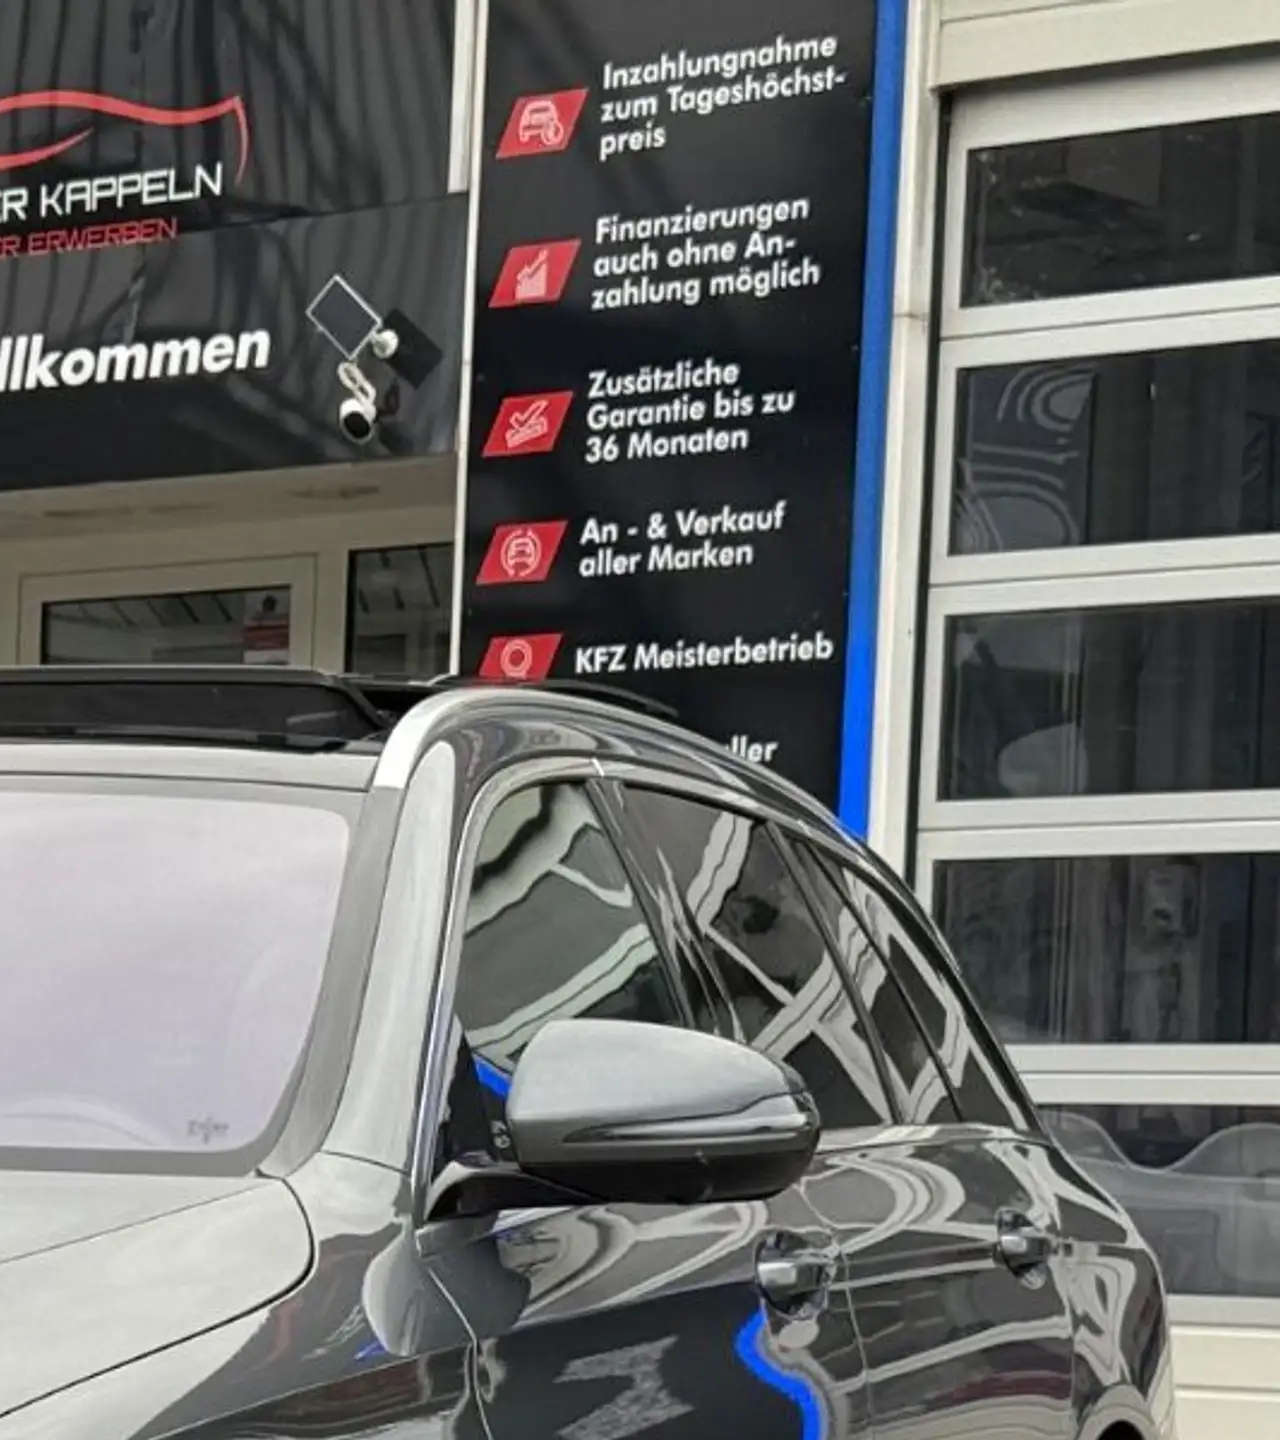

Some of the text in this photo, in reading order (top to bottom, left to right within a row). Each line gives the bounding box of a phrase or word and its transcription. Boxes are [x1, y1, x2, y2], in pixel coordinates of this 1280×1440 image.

[603, 33, 838, 90] Inzahlungnahme
[600, 67, 846, 123] zum Tageshöchst-
[598, 121, 666, 162] preis
[41, 161, 223, 219] KAPPELN
[28, 216, 178, 256] ERWERBEN
[595, 198, 810, 245] Finanzierungen
[593, 231, 796, 277] auch ohne An-
[590, 258, 820, 312] zahlung möglich
[588, 359, 740, 399] Zusätzliche
[586, 389, 796, 431] Garantie bis zu
[584, 427, 749, 464] 36 Monaten
[647, 511, 669, 540] &
[674, 501, 787, 538] Verkauf
[578, 542, 754, 578] aller Marken
[574, 631, 835, 674] KFZ Meisterbetrieb
[723, 734, 779, 763] ller
